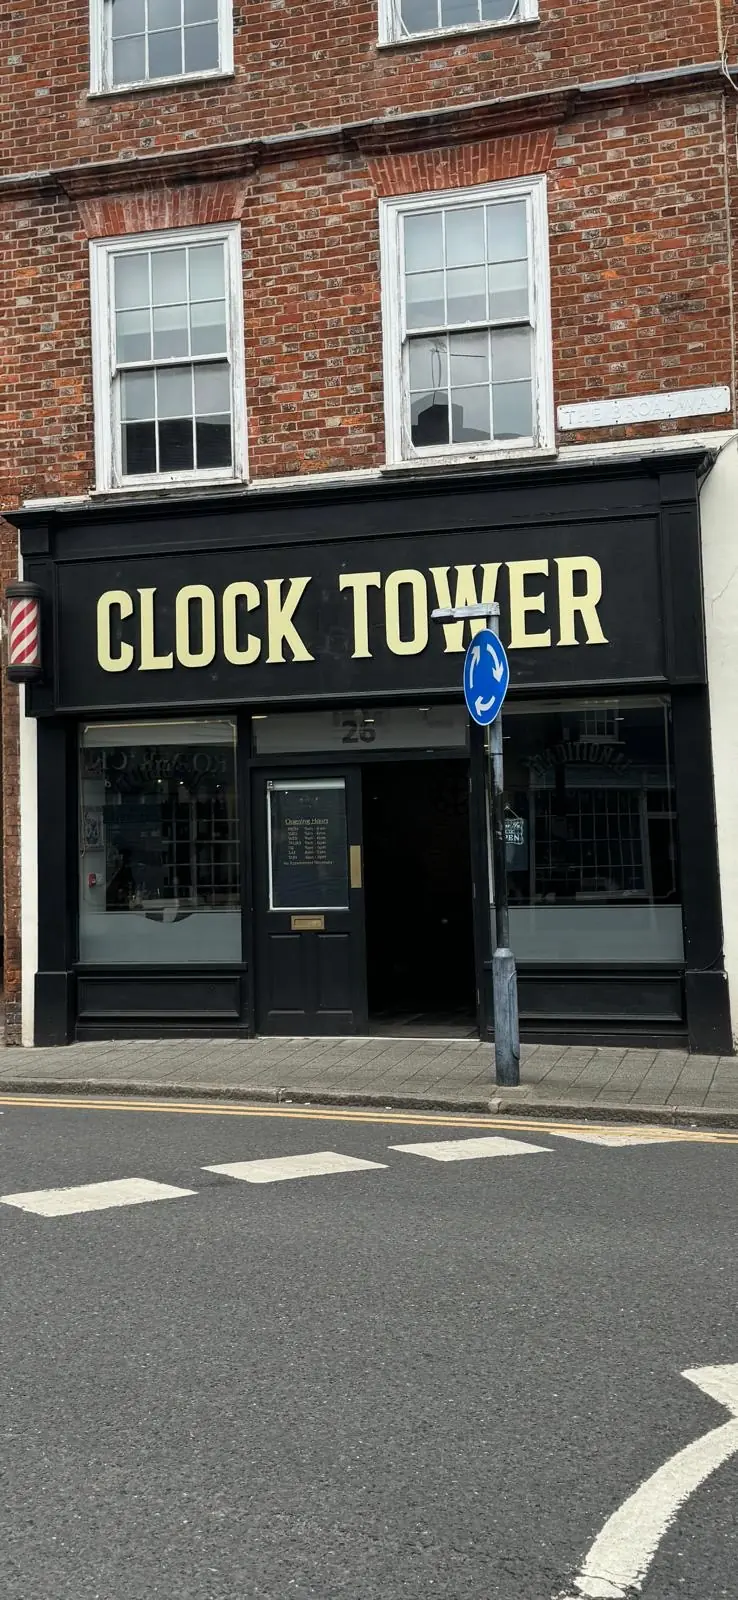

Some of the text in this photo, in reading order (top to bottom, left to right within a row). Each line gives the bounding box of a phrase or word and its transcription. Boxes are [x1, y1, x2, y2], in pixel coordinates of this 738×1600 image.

[564, 390, 723, 424] THE BROADWAY
[96, 555, 610, 673] CLOCK TOWER
